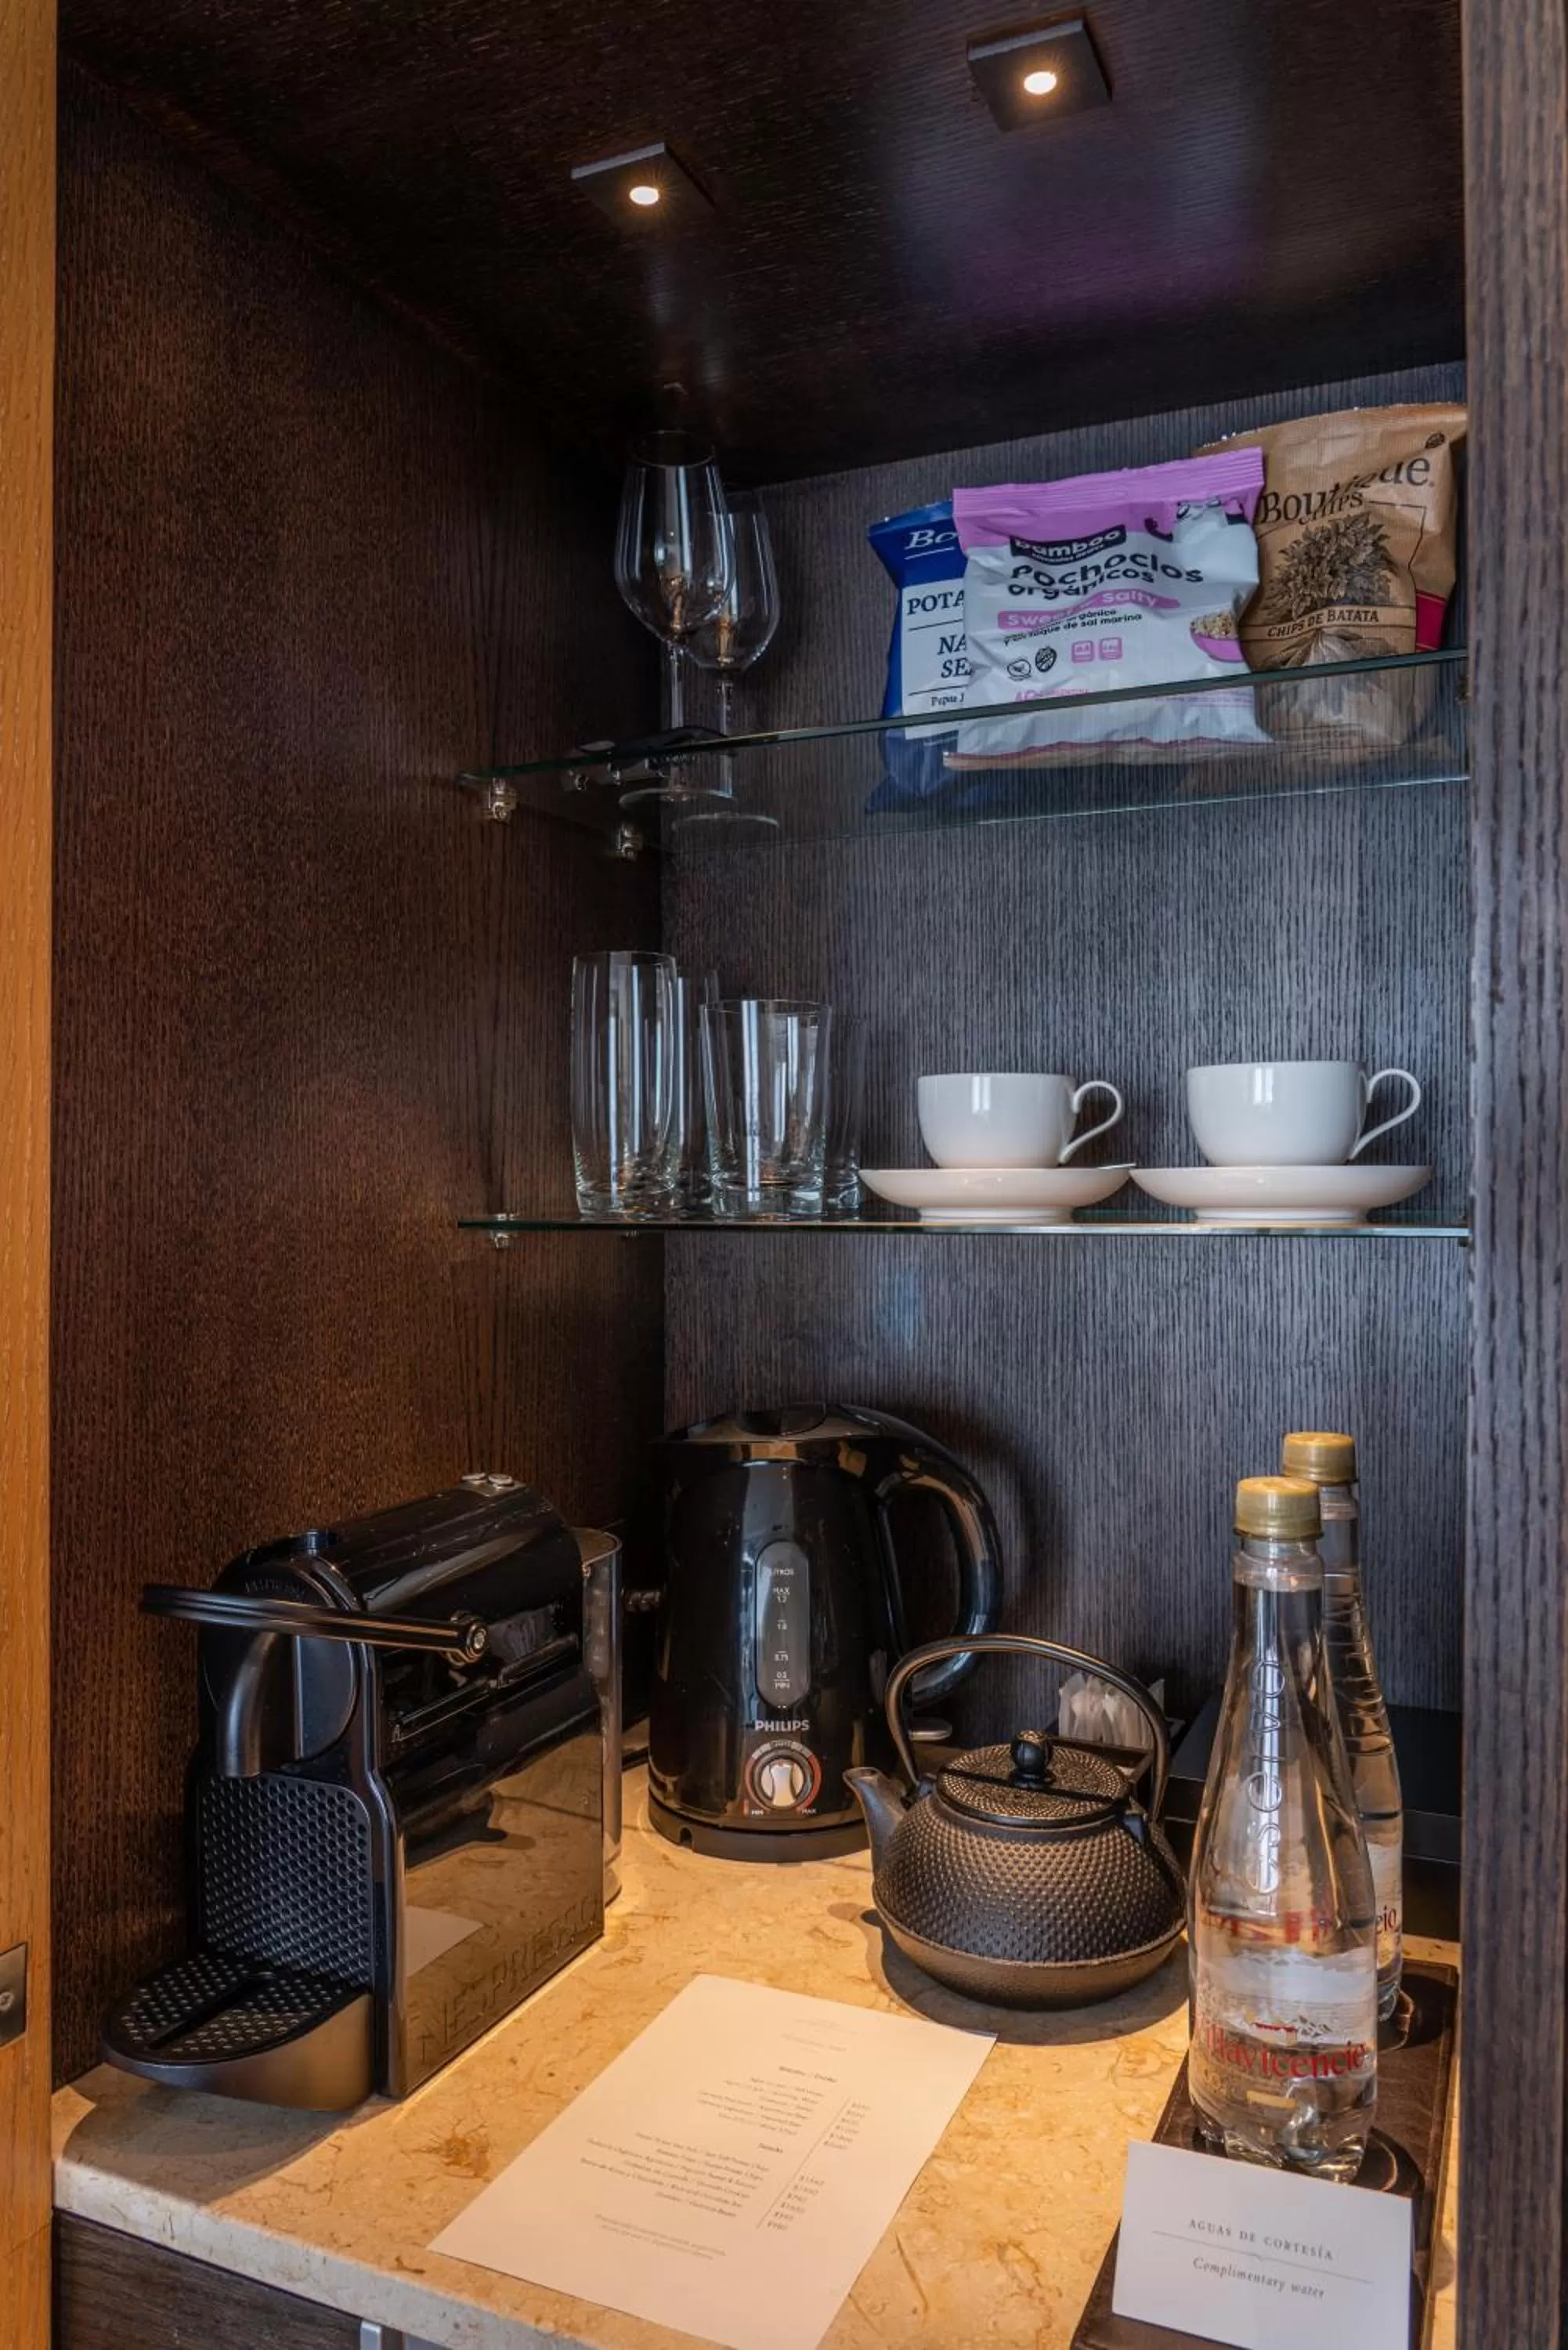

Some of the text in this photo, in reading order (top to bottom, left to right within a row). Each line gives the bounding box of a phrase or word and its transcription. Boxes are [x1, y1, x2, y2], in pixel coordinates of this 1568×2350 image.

[1267, 609, 1379, 638] CHIPS DE BATATA
[754, 1719, 811, 1732] PHILIPS
[1189, 2218, 1335, 2261] AGUAS DE CORTESÍA
[1192, 2257, 1325, 2298] Complimentary water
